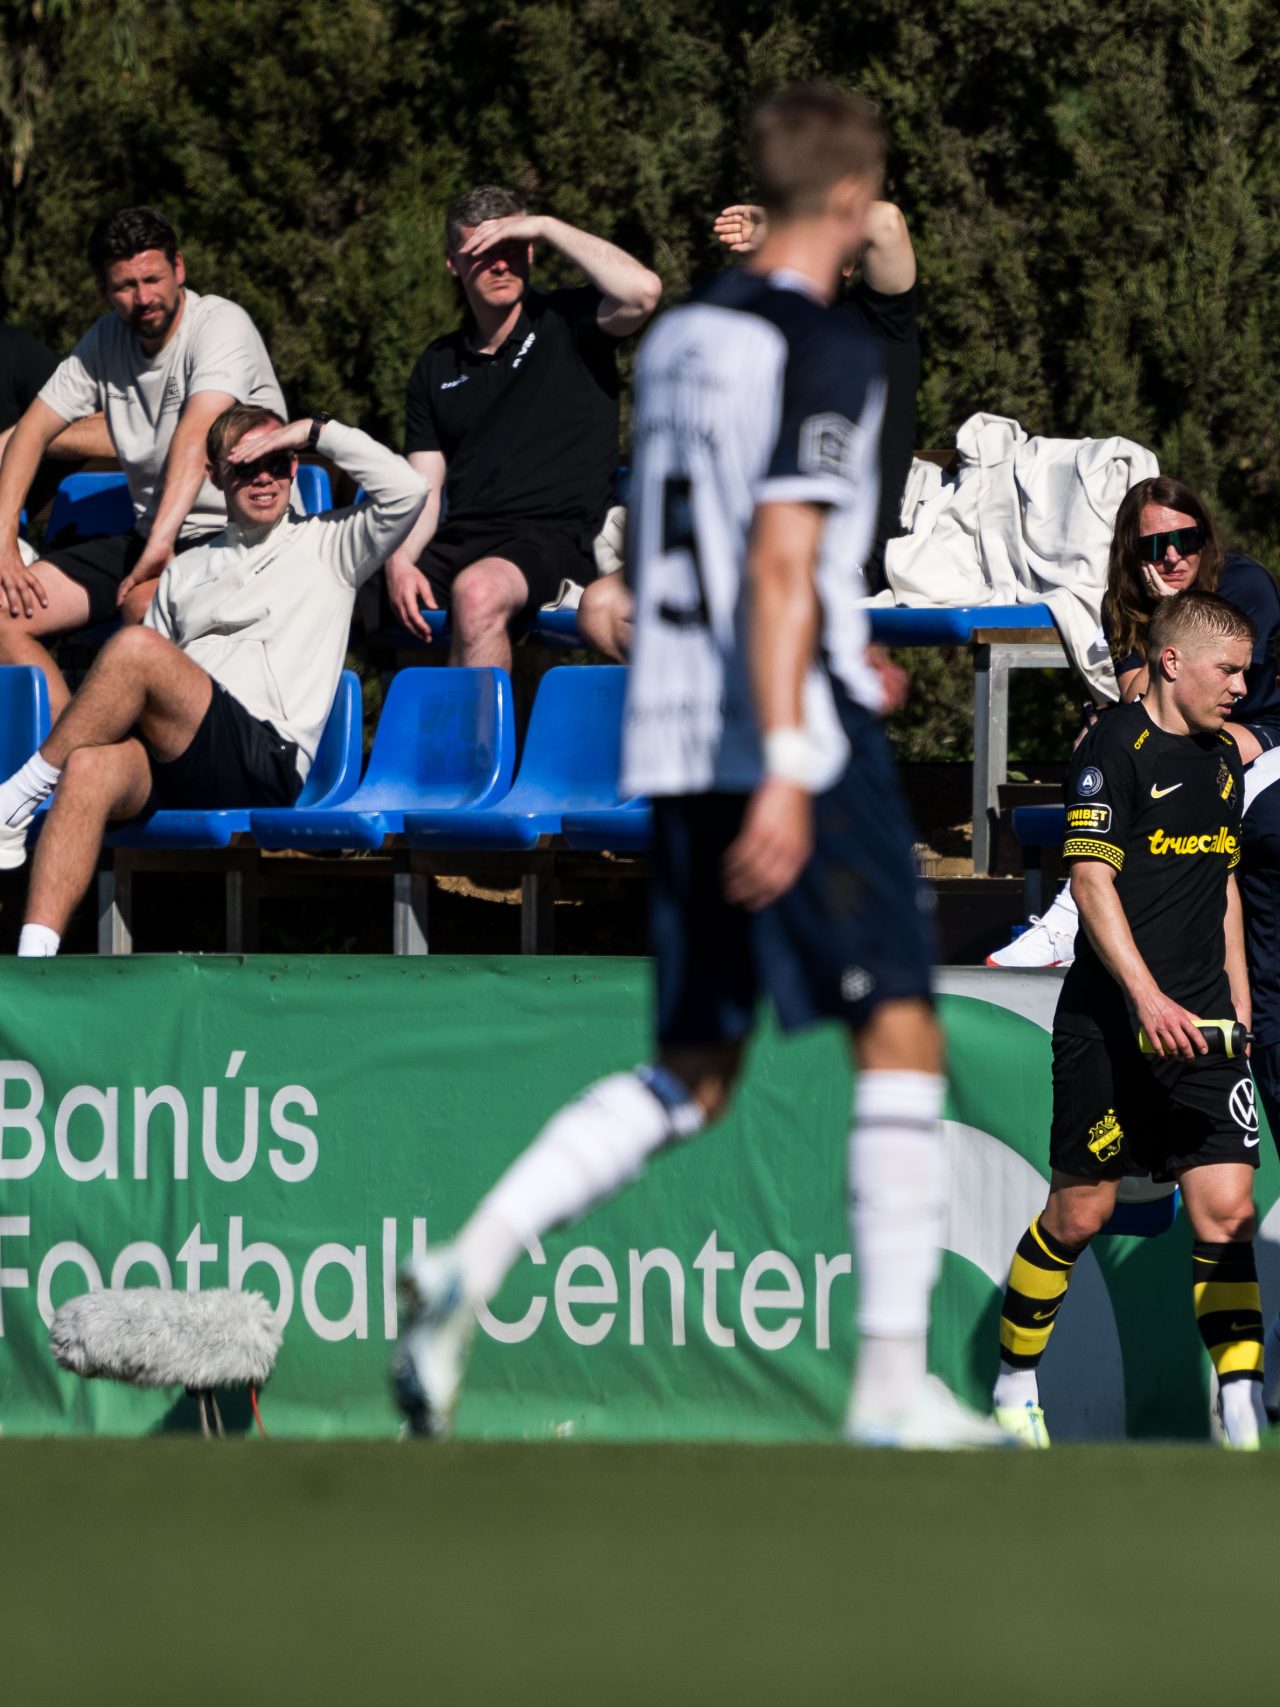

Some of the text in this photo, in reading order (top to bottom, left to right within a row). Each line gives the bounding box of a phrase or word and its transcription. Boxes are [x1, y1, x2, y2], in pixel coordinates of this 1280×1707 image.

[1067, 808, 1108, 821] UNIBET
[1147, 826, 1238, 855] truecalle
[0, 1050, 319, 1183] Banús
